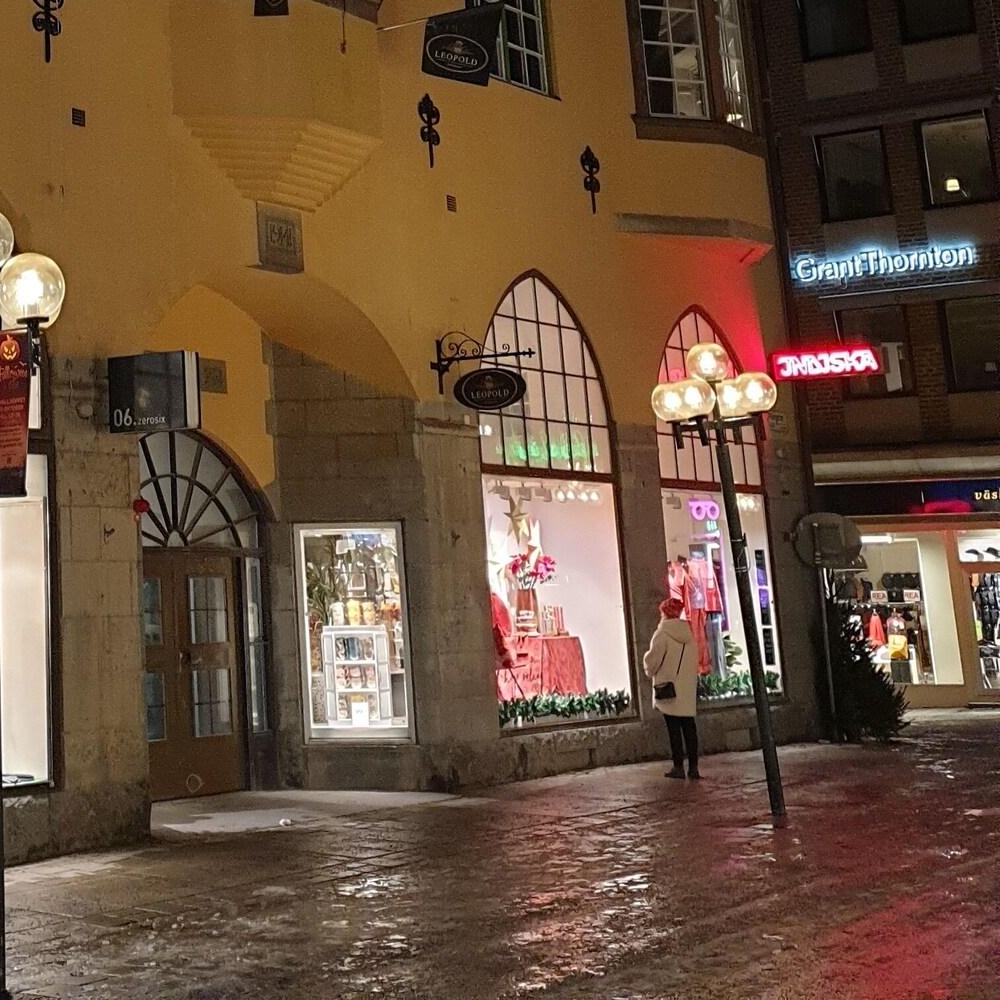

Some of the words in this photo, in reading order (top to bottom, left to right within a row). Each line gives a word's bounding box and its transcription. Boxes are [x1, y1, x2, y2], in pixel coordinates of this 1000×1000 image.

[433, 49, 478, 67] LEOPOLD
[795, 253, 862, 283] Grant
[860, 246, 975, 276] Thornton
[470, 388, 510, 399] LEOPOLD
